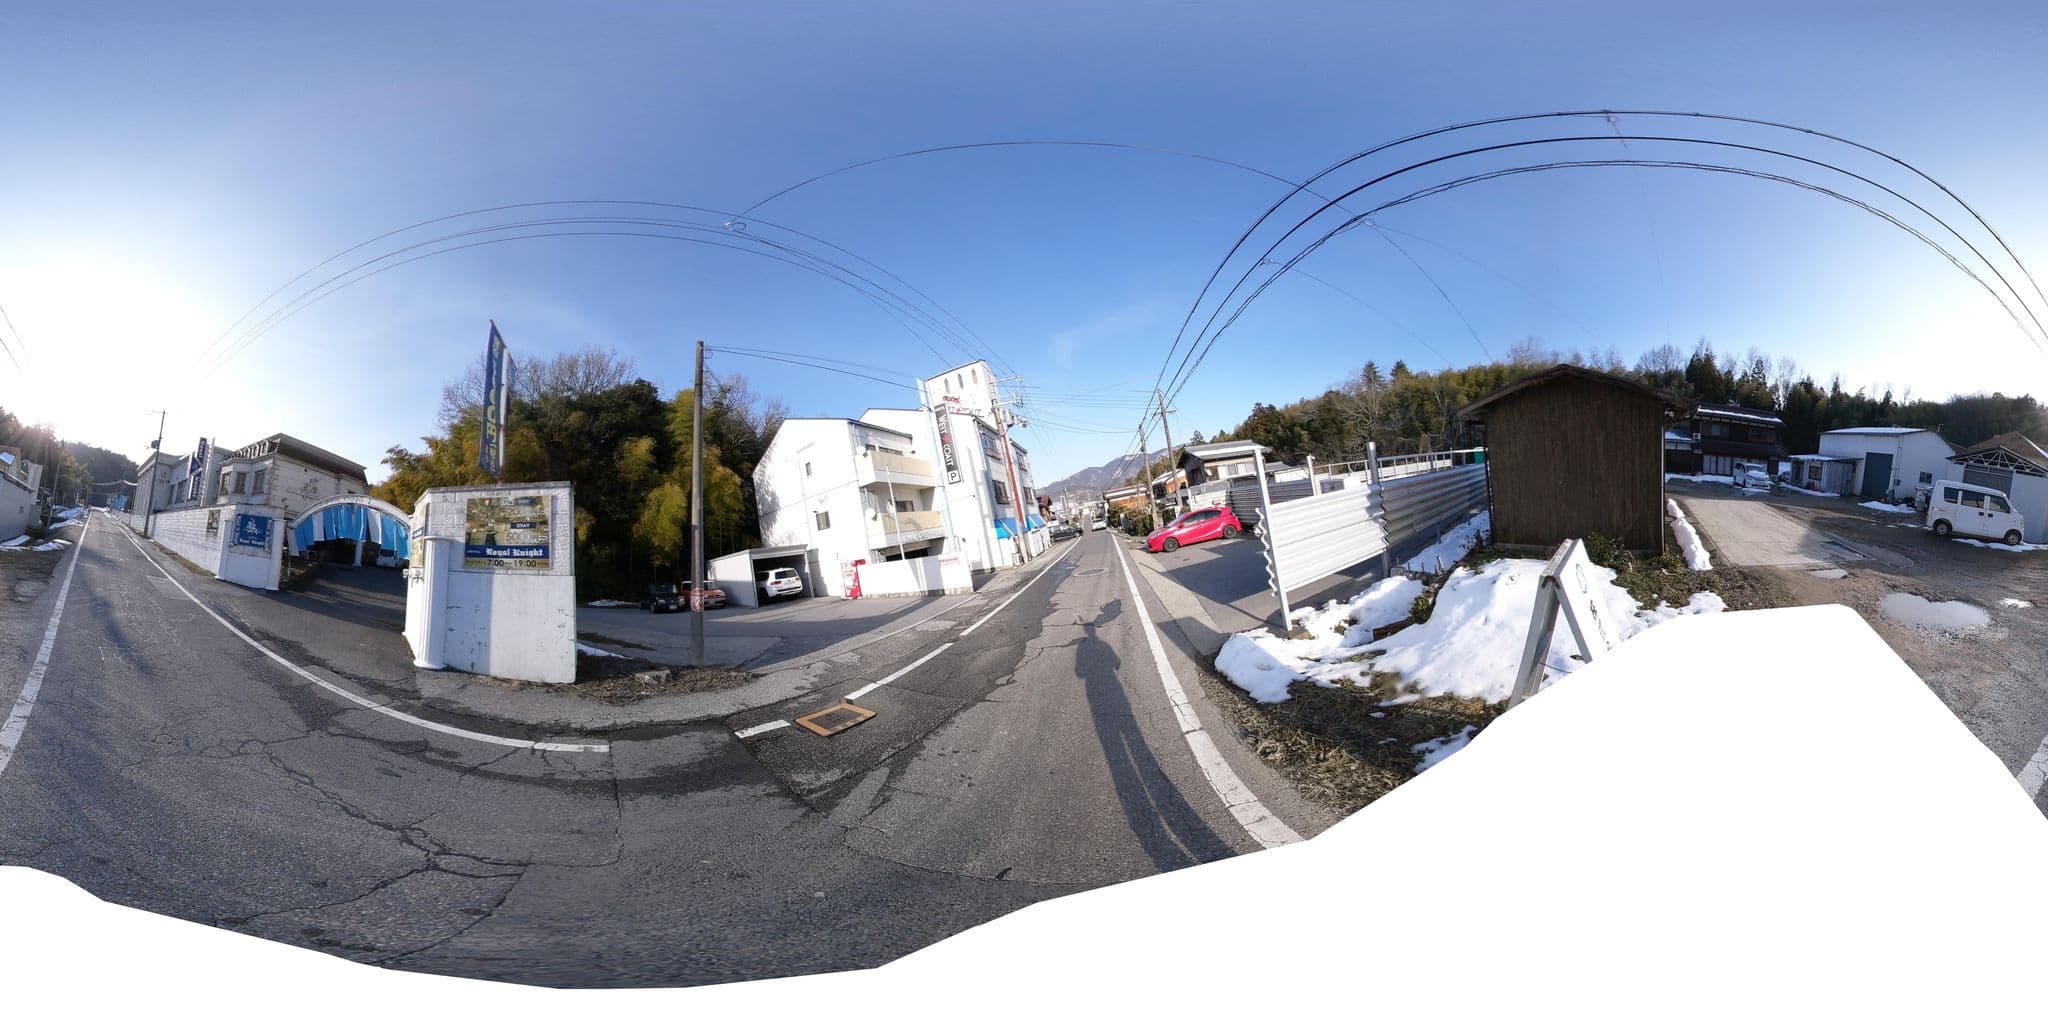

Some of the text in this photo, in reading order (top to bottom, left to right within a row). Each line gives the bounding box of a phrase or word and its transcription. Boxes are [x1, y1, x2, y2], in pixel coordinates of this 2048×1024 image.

[950, 472, 957, 480] P
[485, 548, 510, 557] Royal
[512, 548, 543, 557] Knight
